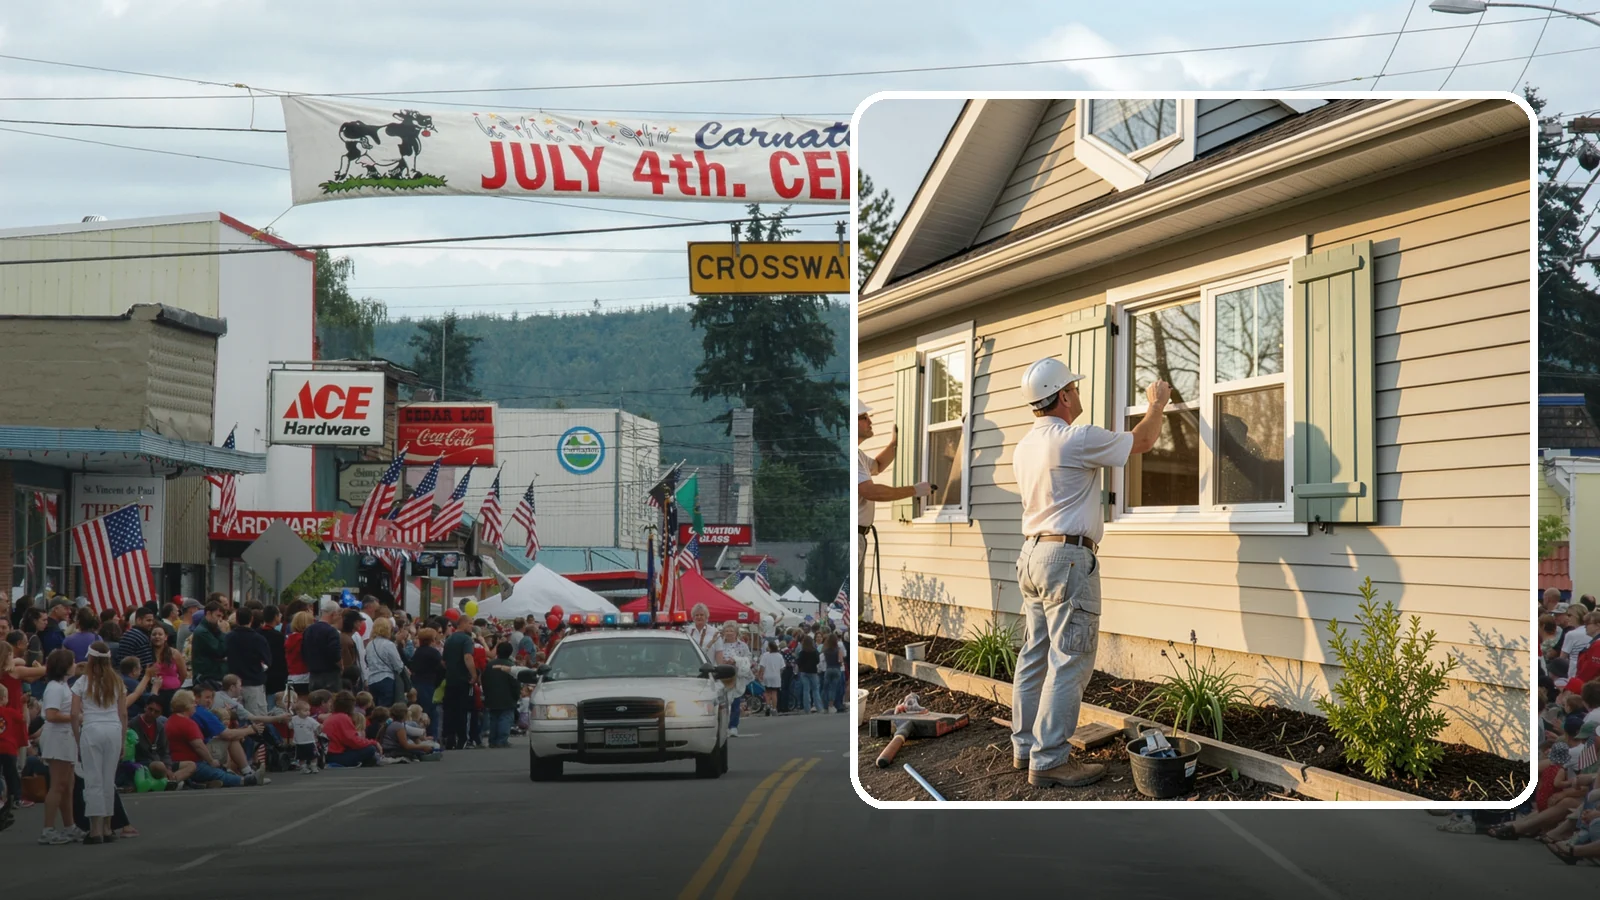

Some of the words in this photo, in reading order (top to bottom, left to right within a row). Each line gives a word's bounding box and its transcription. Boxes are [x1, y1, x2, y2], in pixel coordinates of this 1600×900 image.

[481, 141, 604, 193] JULY
[632, 150, 746, 198] 4th.
[697, 254, 850, 280] CROSSWA
[282, 380, 373, 420] ACE
[405, 409, 453, 422] CEDAR
[461, 409, 485, 422] LOG
[283, 421, 371, 437] Hardware
[416, 428, 477, 447] Coca-Cola
[353, 467, 384, 480] Simpl
[95, 485, 124, 495] Vincent
[126, 486, 136, 495] de
[137, 486, 155, 495] Paul
[688, 526, 741, 535] CRNATION
[699, 535, 730, 543] GLASS
